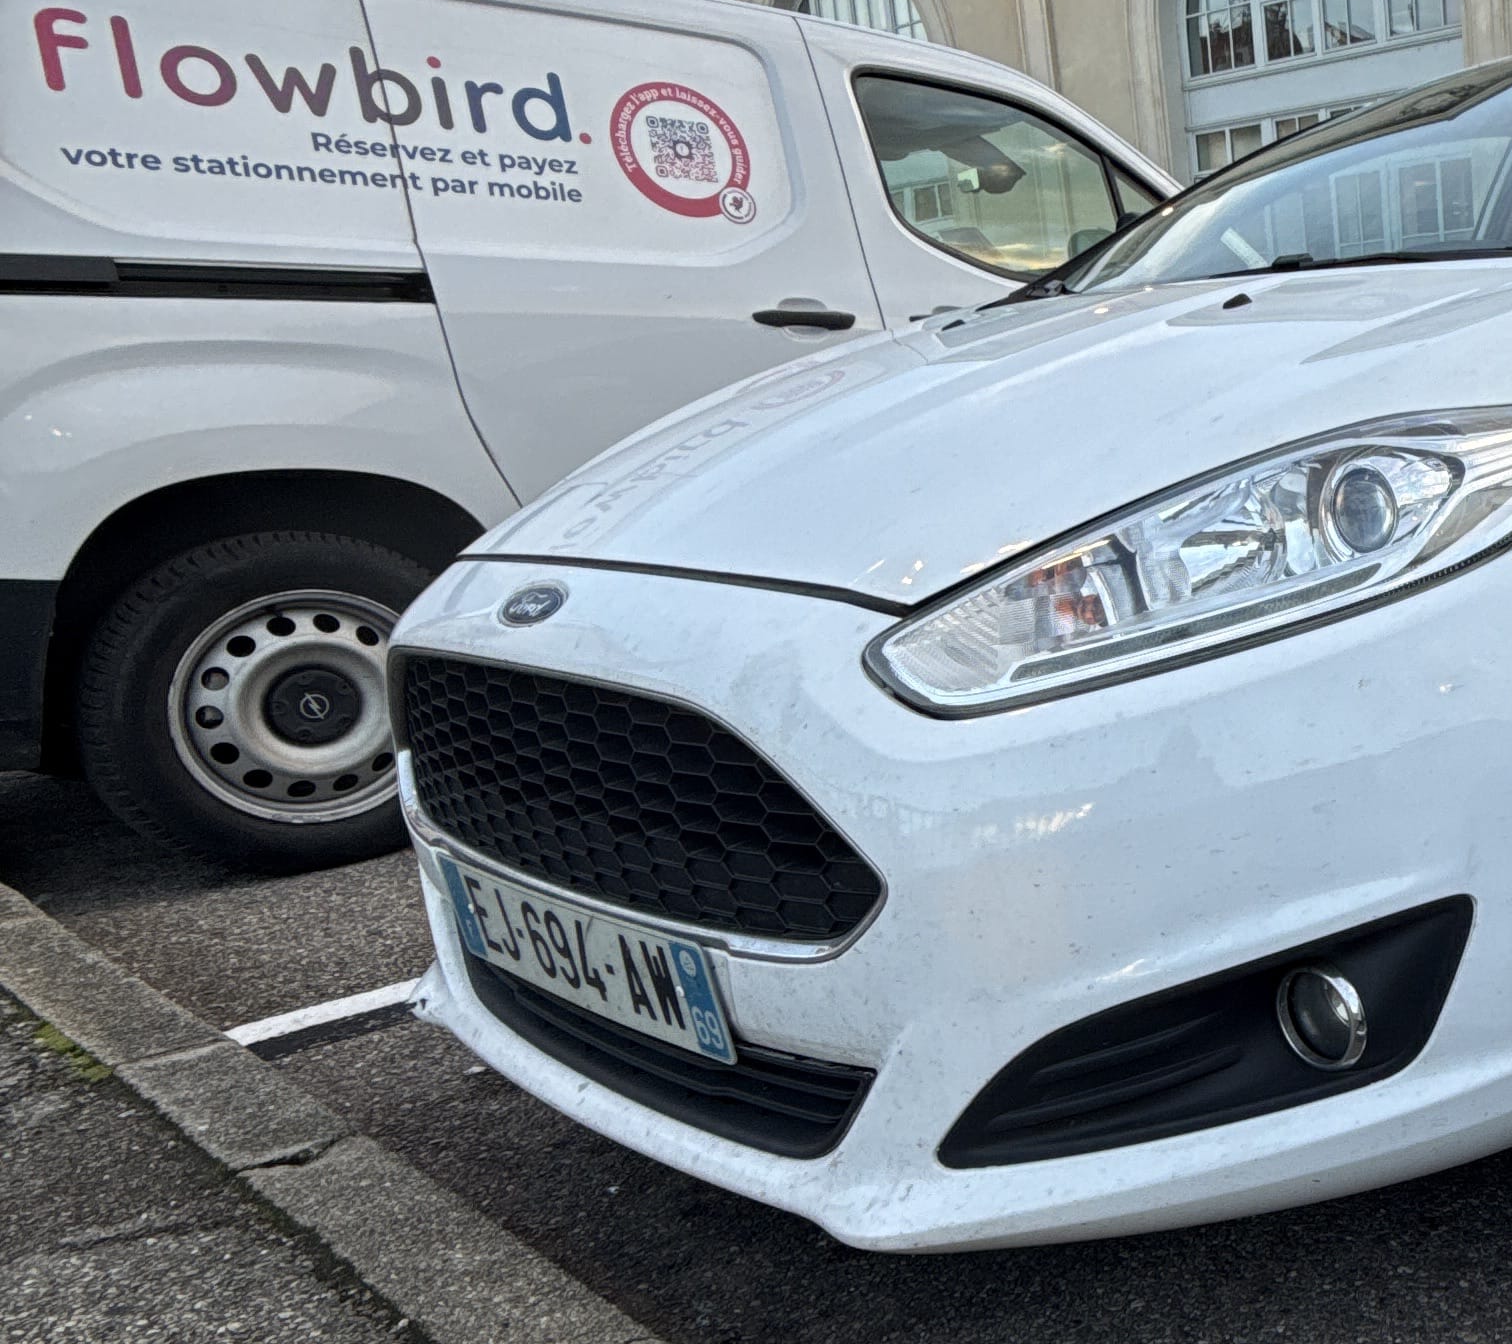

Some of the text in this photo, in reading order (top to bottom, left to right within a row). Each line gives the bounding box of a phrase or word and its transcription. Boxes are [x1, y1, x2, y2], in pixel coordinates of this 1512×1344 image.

[311, 131, 579, 176] Réservez et payez
[660, 87, 673, 97] et
[732, 147, 747, 185] guider
[60, 147, 583, 203] votre stationnement par mobile
[464, 874, 687, 1031] EJ-694-AW
[691, 1006, 725, 1051] 69
